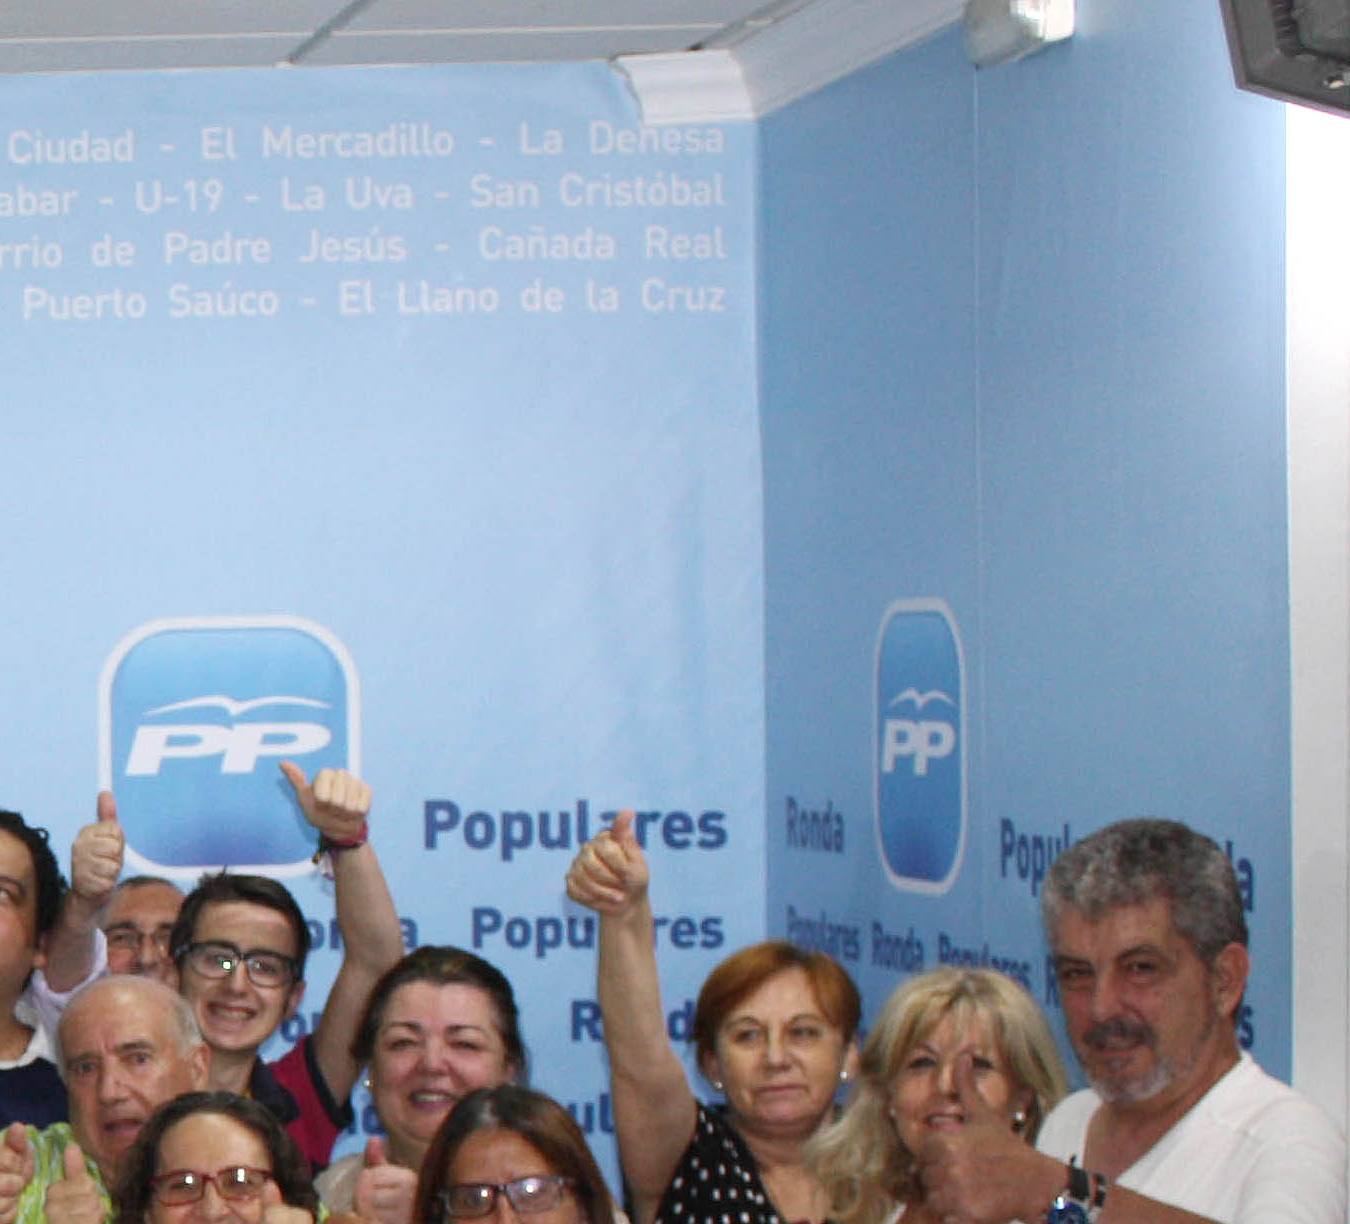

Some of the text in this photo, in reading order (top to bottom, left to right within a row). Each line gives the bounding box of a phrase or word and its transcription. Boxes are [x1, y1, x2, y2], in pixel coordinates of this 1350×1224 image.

[7, 127, 135, 165] Ciudad
[200, 125, 238, 160] El
[261, 120, 455, 159] Mercadillo
[520, 121, 564, 156] La
[135, 178, 224, 214] U-19
[280, 178, 327, 211] La
[345, 176, 416, 210] Uva
[469, 172, 540, 208] San
[559, 172, 726, 207] Cristóbal
[91, 234, 137, 267] de
[164, 230, 272, 265] Padre
[298, 226, 408, 263] Jesús
[478, 225, 616, 261] Cañada
[645, 224, 727, 259] Real
[22, 284, 148, 320] Puerto
[168, 280, 280, 318] Saúco
[339, 279, 376, 315] El
[397, 280, 500, 315] Llano
[520, 279, 566, 313] de
[586, 279, 620, 313] la
[641, 276, 726, 312] Cruz
[124, 721, 342, 777] PP
[880, 717, 955, 776] PP
[785, 796, 845, 854] Ronda
[471, 906, 726, 960] Popures
